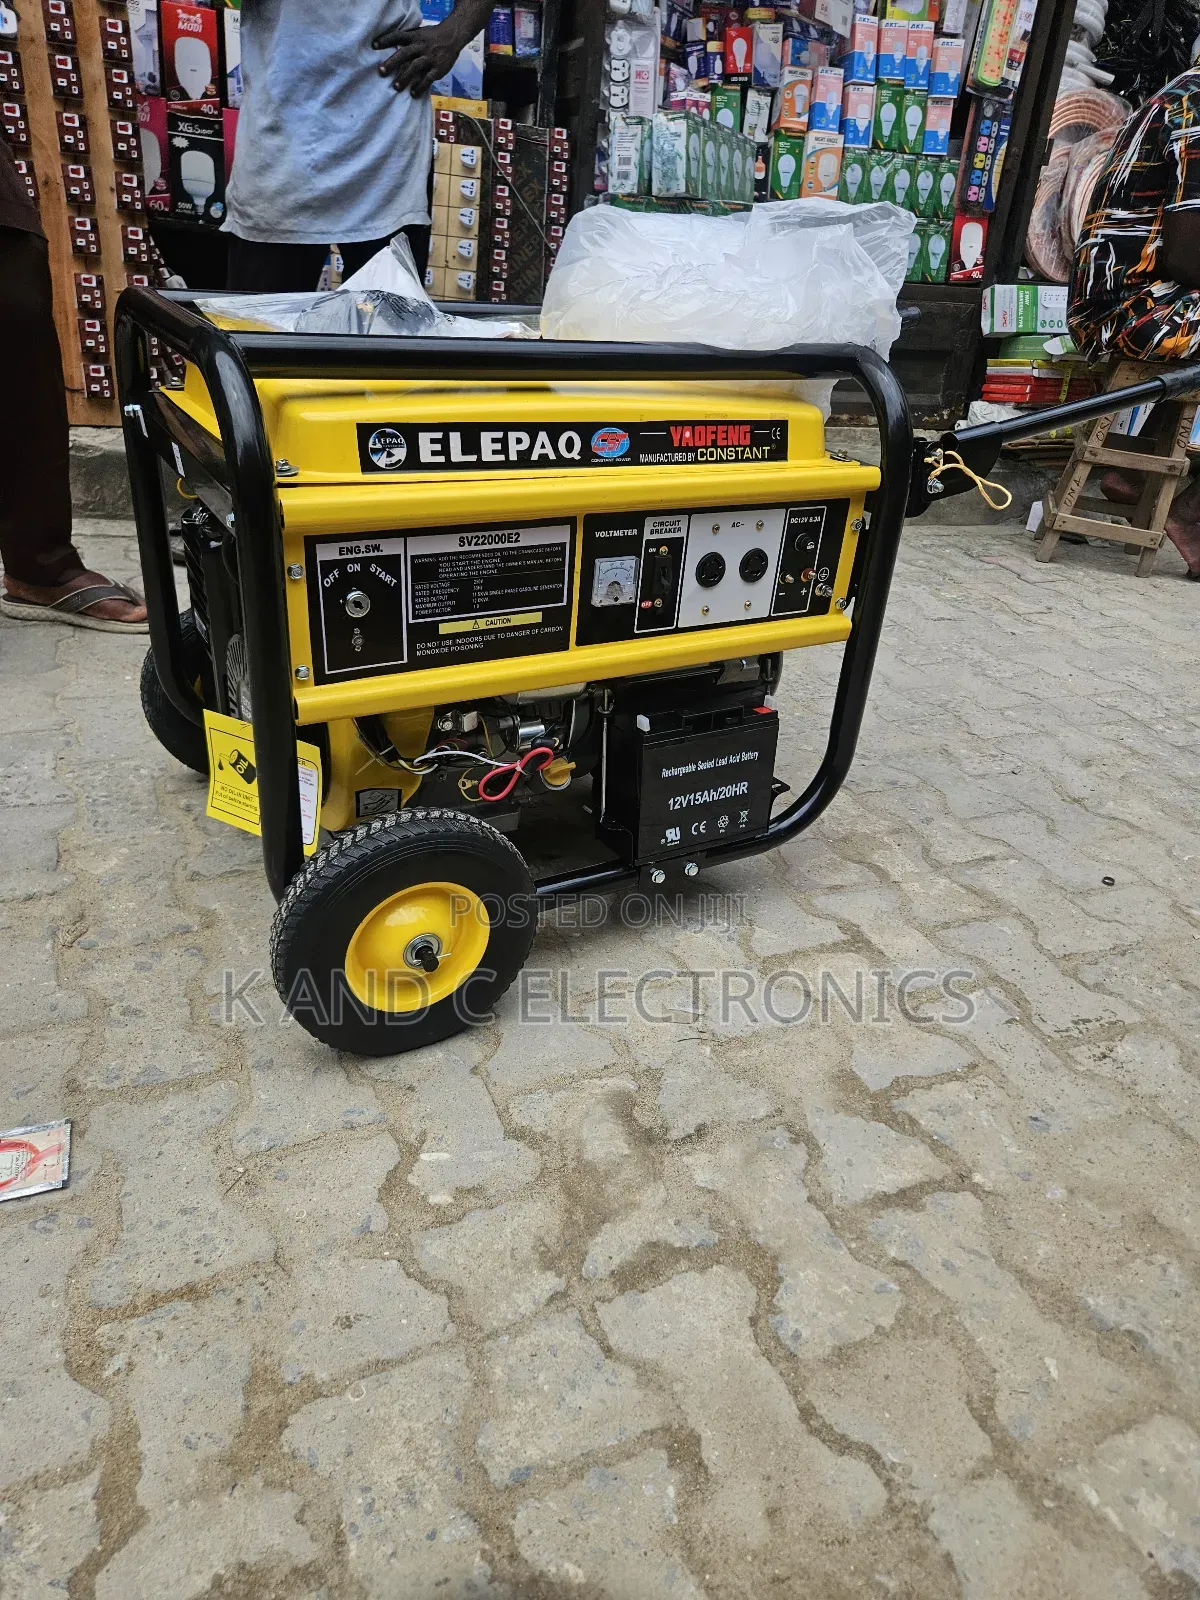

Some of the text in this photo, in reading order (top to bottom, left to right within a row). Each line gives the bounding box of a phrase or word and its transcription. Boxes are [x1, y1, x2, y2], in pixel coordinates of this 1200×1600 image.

[178, 22, 202, 32] MODI
[670, 424, 751, 447] YAOFENG
[418, 430, 582, 463] ELEPAQ
[640, 446, 770, 463] MANUFACTURED BY CONSTANT
[652, 520, 681, 528] CIRCUIT
[790, 516, 808, 524] DC12V
[594, 528, 638, 538] VOLTMETER
[650, 526, 682, 535] BREAKER
[458, 532, 521, 548] SV22000E2
[338, 544, 384, 556] ENG.SW.
[346, 562, 360, 573] ON
[369, 563, 398, 587] START
[324, 568, 340, 588] OFF
[485, 618, 512, 626] CAUTION
[456, 636, 483, 645] INDOORS
[506, 630, 530, 638] DANGER
[416, 643, 484, 656] MONOXIDE POISONING
[236, 758, 249, 775] OIL
[661, 750, 759, 778] Rechargeable Sealed Lead Acid Battery
[668, 781, 749, 811] 12V15Ah/20HR
